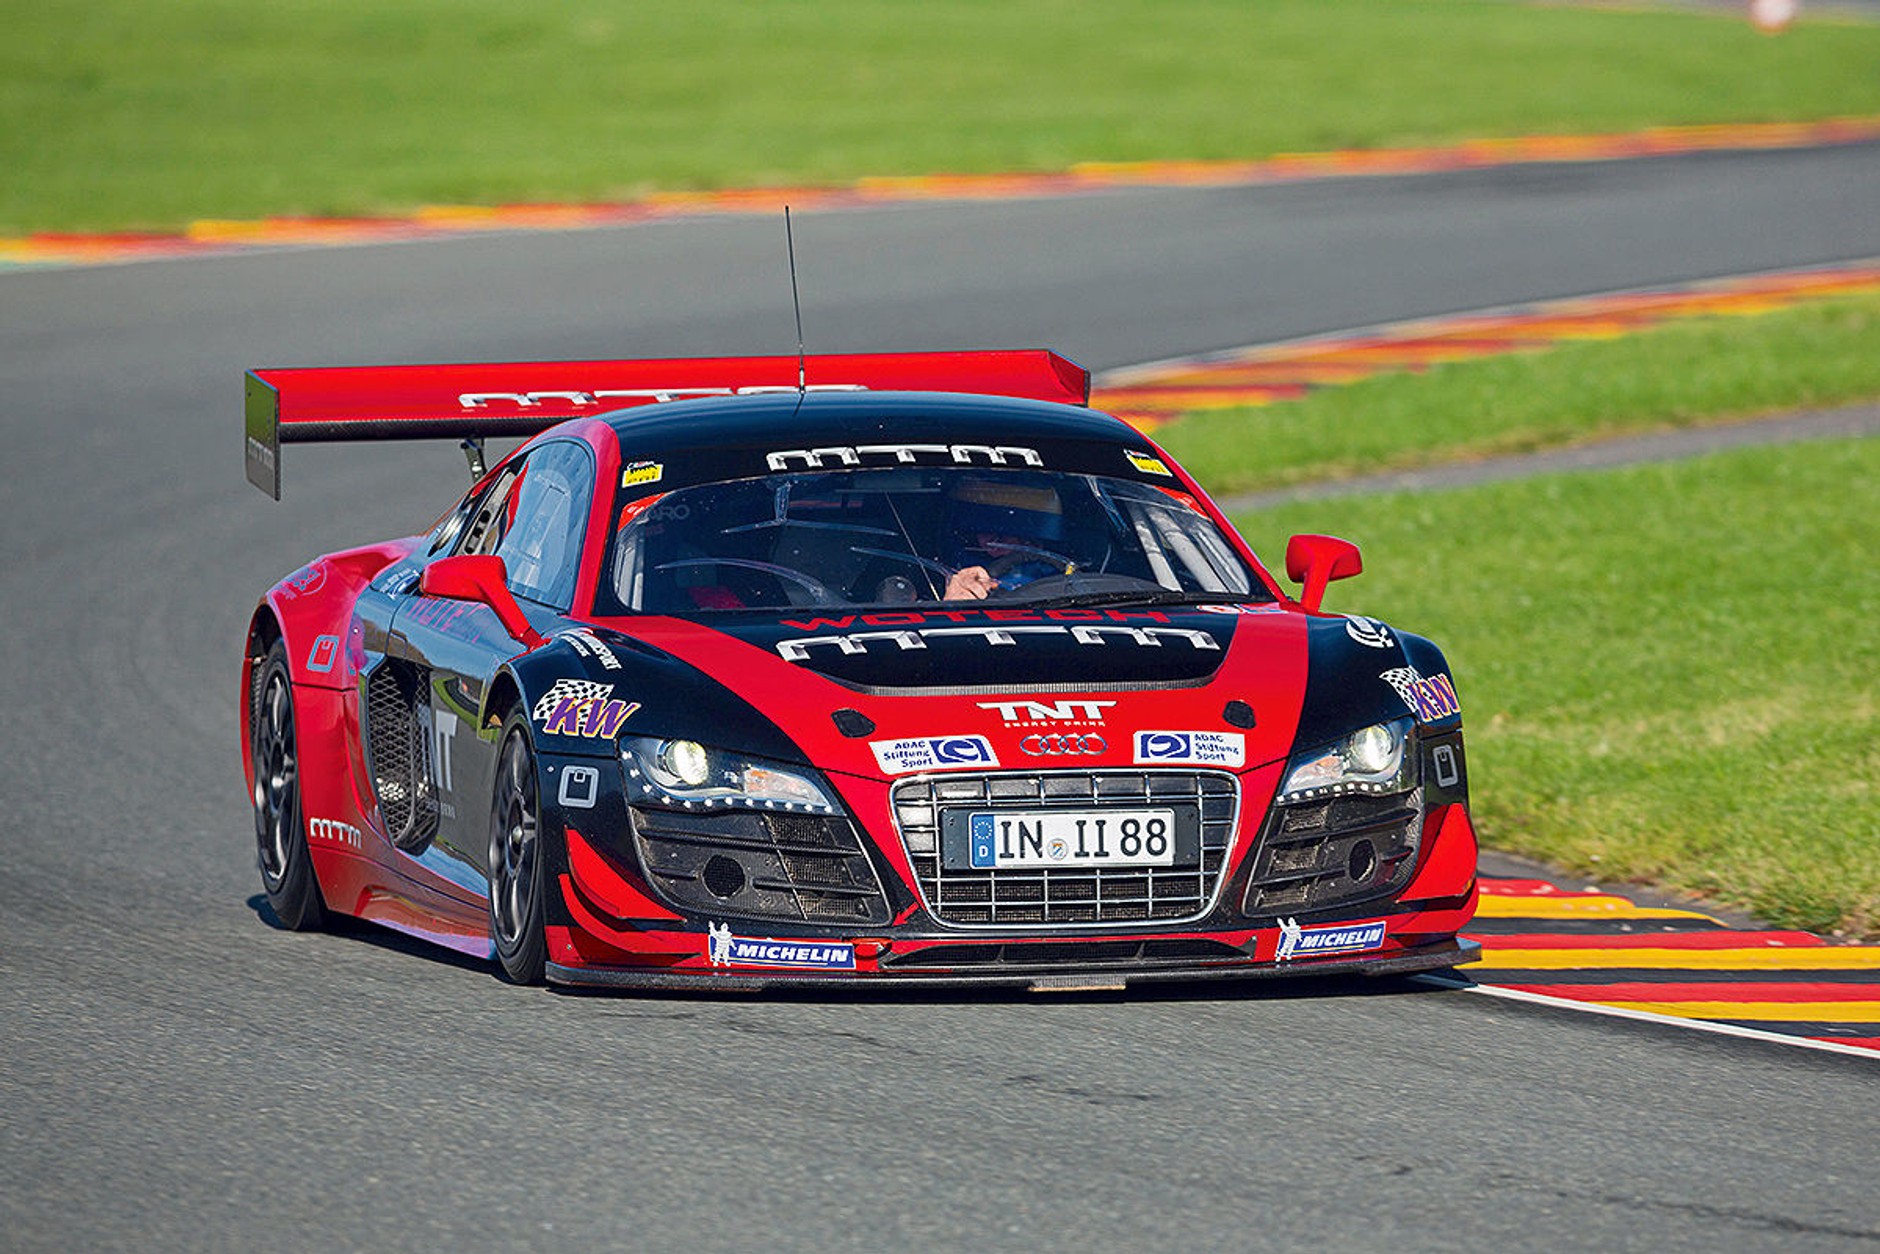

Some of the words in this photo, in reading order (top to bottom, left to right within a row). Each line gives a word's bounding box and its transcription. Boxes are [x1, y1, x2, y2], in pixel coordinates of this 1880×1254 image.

[778, 609, 1171, 632] WOTECH
[1404, 672, 1461, 723] KW
[542, 696, 642, 740] KW
[976, 701, 1117, 721] TNT
[894, 740, 926, 750] ADAC
[1194, 733, 1224, 743] ADAC
[883, 750, 930, 761] Stiftung
[1194, 743, 1240, 755] Stiftung
[1195, 751, 1227, 761] Sport
[901, 757, 933, 768] Sport
[999, 820, 1043, 858] IN
[1074, 820, 1110, 857] II
[1120, 818, 1168, 857] 88
[979, 846, 989, 857] D
[1301, 928, 1384, 949] MICHELIN
[737, 943, 849, 963] MICHELIN
